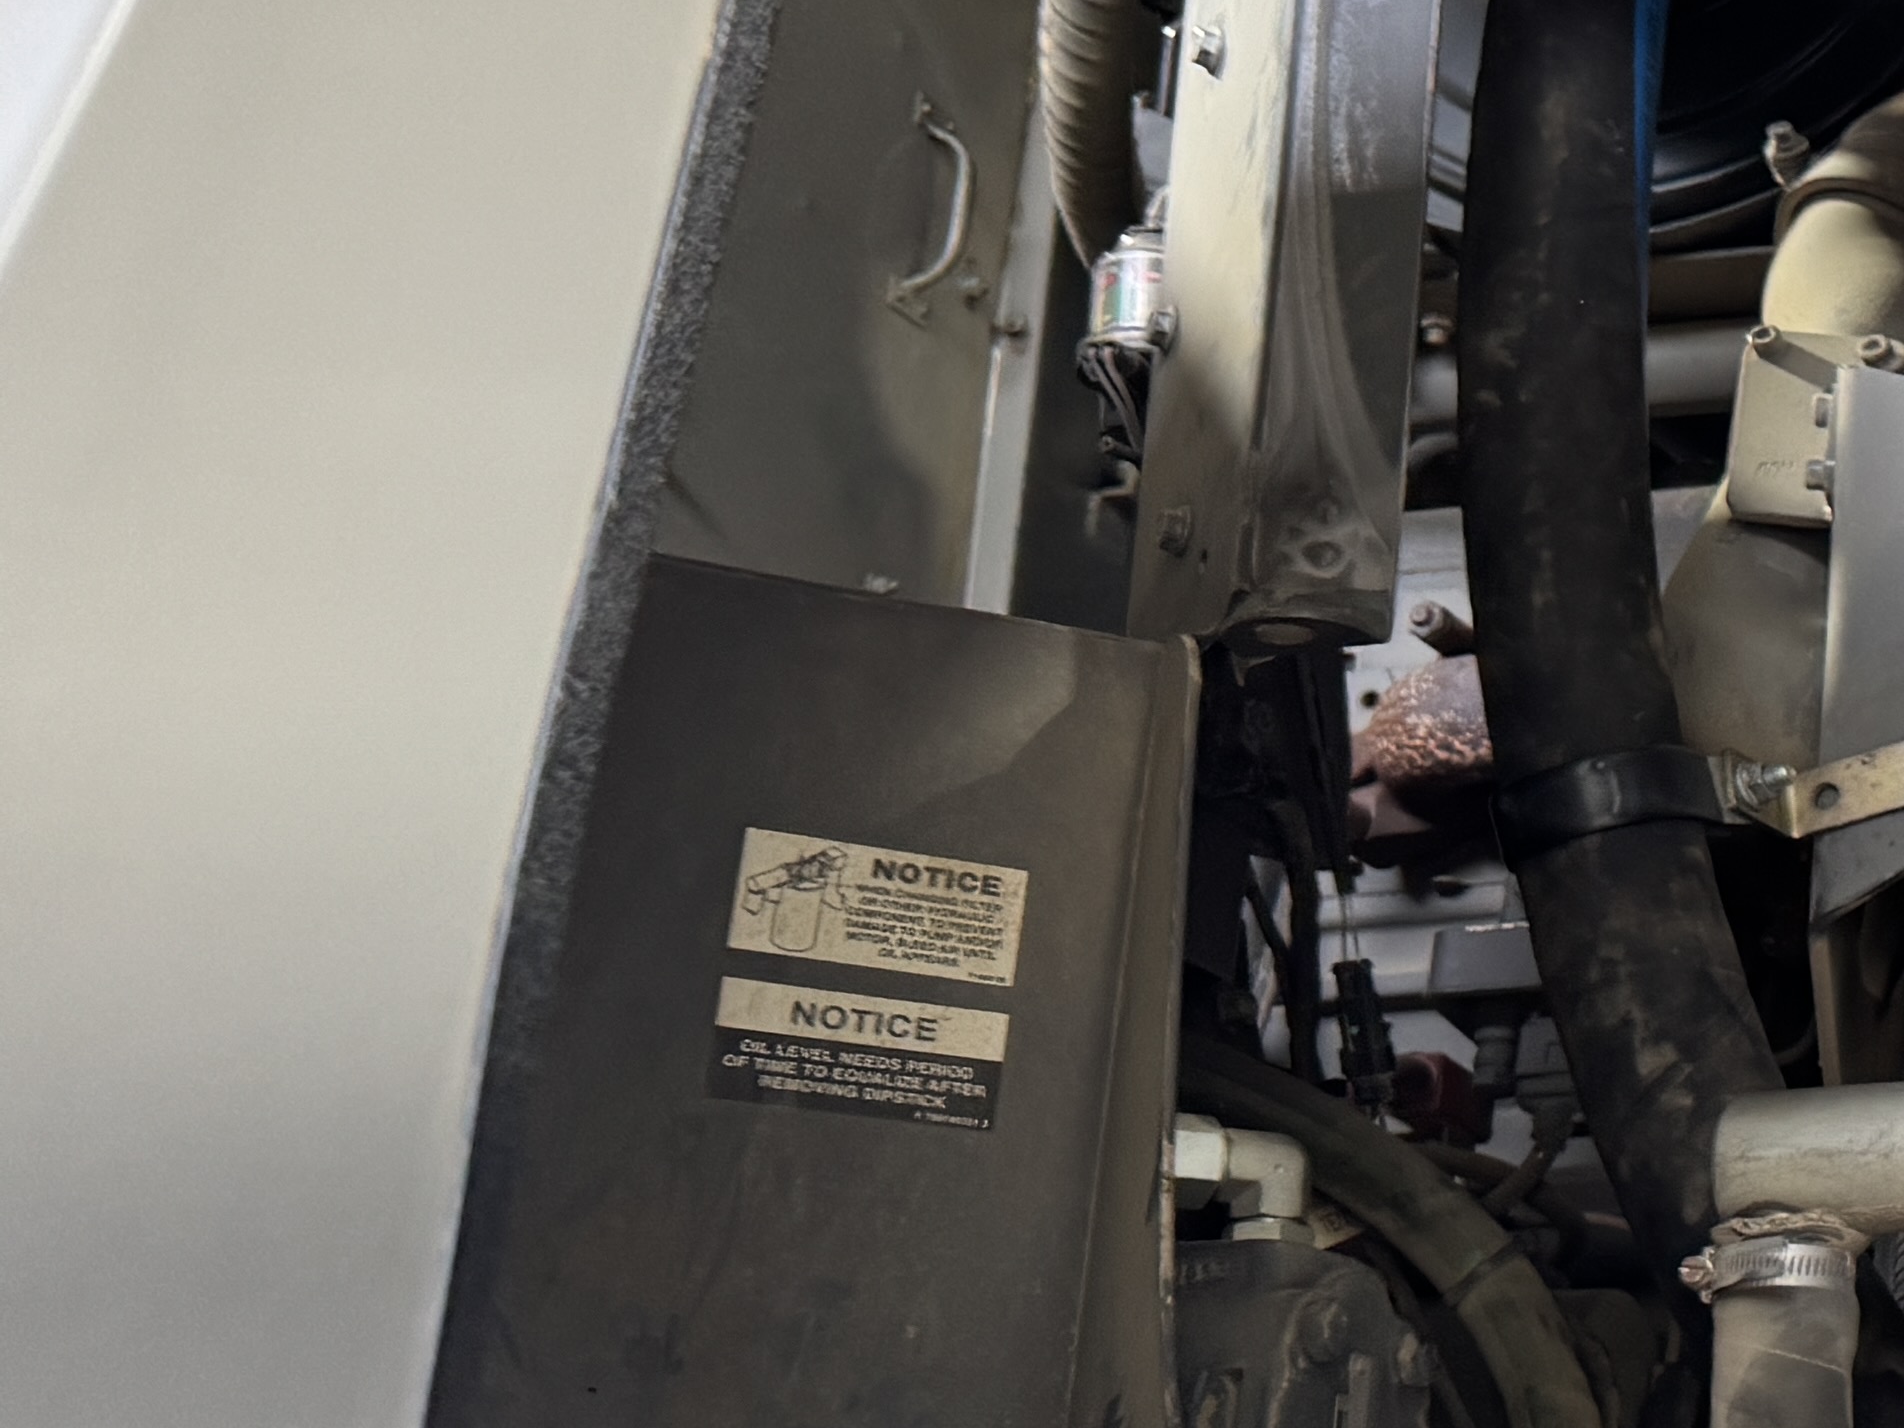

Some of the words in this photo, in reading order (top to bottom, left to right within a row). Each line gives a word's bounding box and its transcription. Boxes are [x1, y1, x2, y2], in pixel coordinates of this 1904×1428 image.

[872, 857, 1003, 897] NOTICE
[790, 1000, 941, 1042] NOTICE
[721, 1054, 749, 1068] OF
[753, 1057, 798, 1076] TIME
[803, 1063, 828, 1078] TO
[832, 1066, 924, 1091] EQUALIZE
[928, 1080, 987, 1099] AFTER
[739, 1039, 771, 1055] OIL
[774, 1043, 835, 1063] LEVEL
[838, 1051, 902, 1071] NEEDS
[905, 1060, 974, 1080] PERIOD
[757, 1074, 859, 1099] REMOVING
[862, 1087, 947, 1110] DIPSTICK
